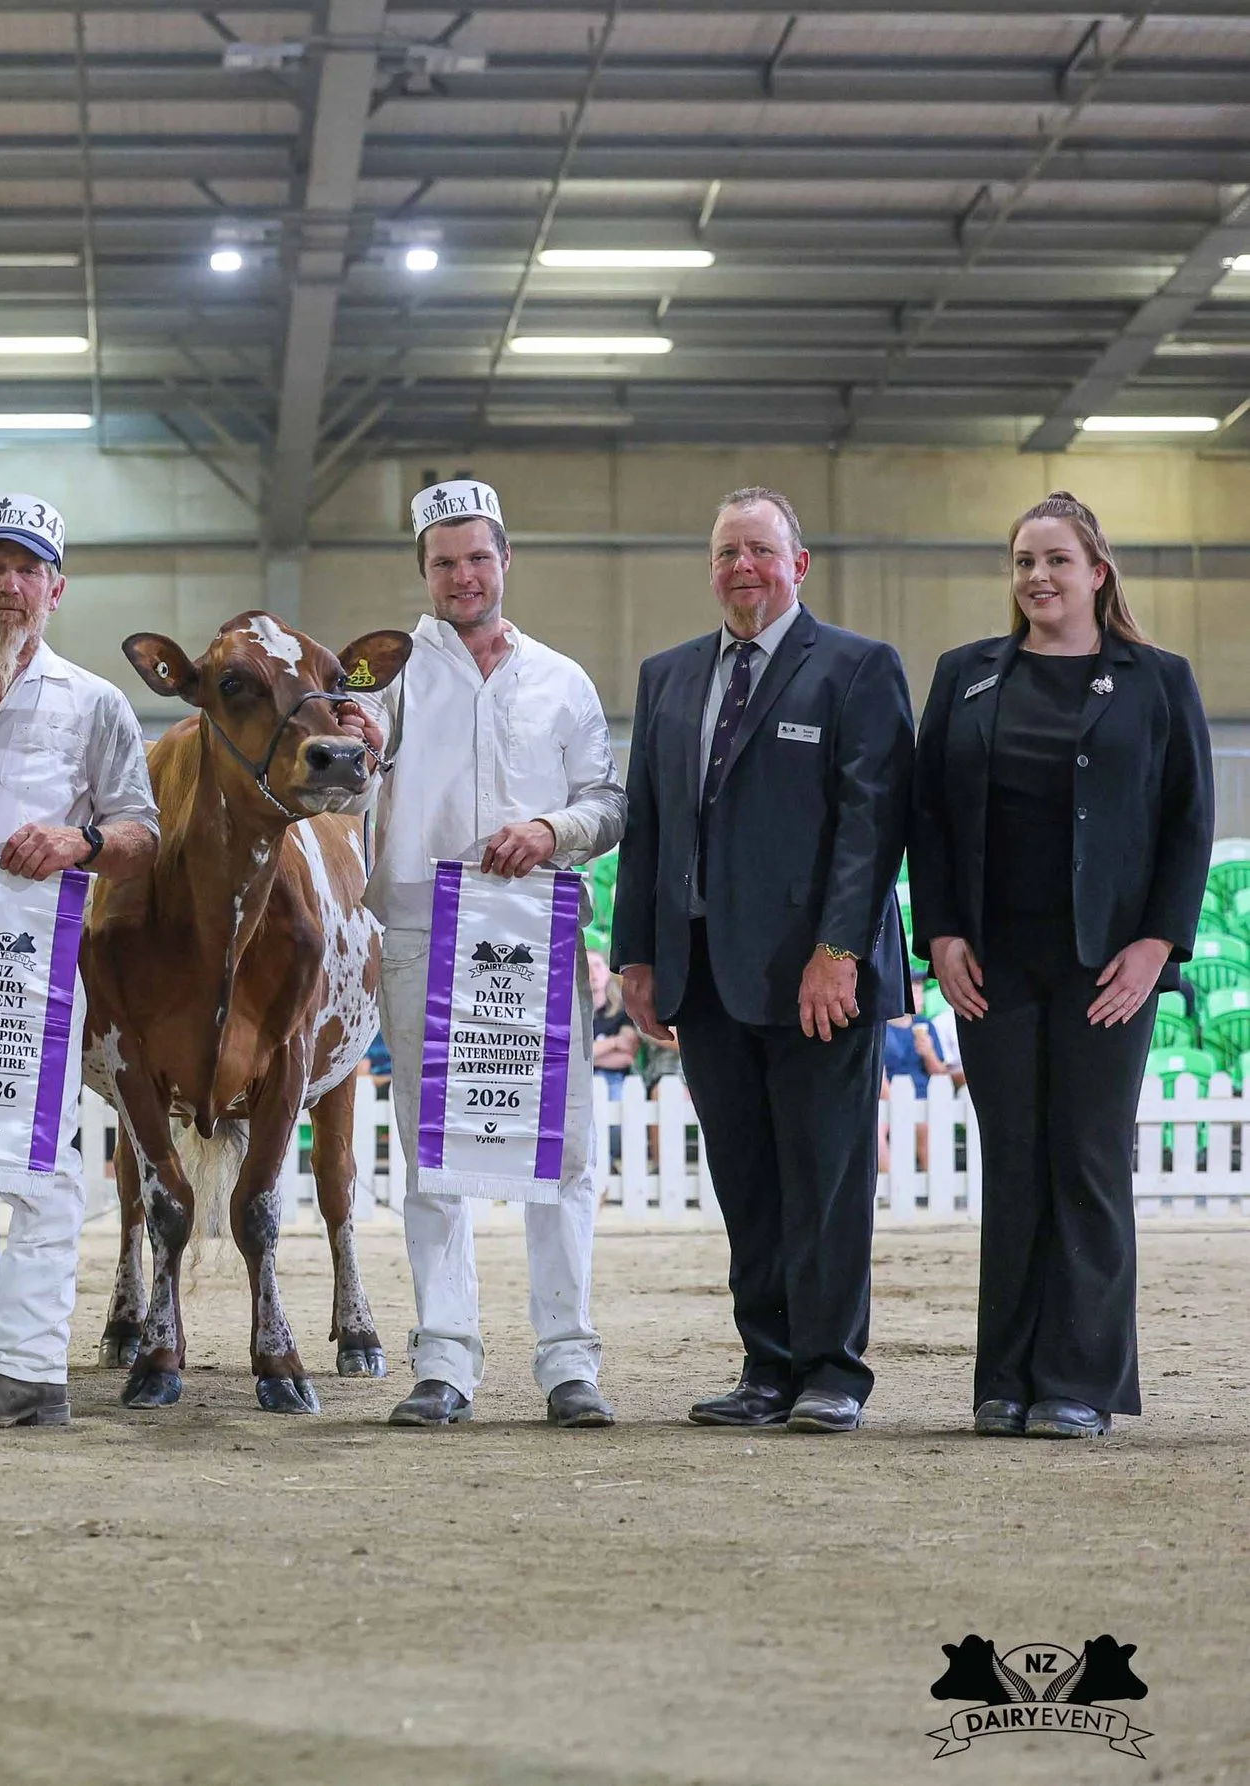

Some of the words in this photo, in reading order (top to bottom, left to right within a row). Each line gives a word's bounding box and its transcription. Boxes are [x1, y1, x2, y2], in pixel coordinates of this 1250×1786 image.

[423, 496, 468, 523] SEMEX
[470, 486, 501, 520] 16
[28, 504, 64, 550] 342
[1, 935, 12, 943] NZ
[498, 947, 508, 955] NZ
[490, 976, 512, 990] NZ
[475, 990, 525, 1005] DAIRY
[472, 1005, 526, 1020] EVENT
[453, 1031, 542, 1047] CHAMPION
[453, 1046, 541, 1062] INTERMEDIATE
[456, 1061, 535, 1076] AYRSHIRE
[466, 1088, 520, 1108] 2026
[475, 1135, 506, 1145] Vytelle
